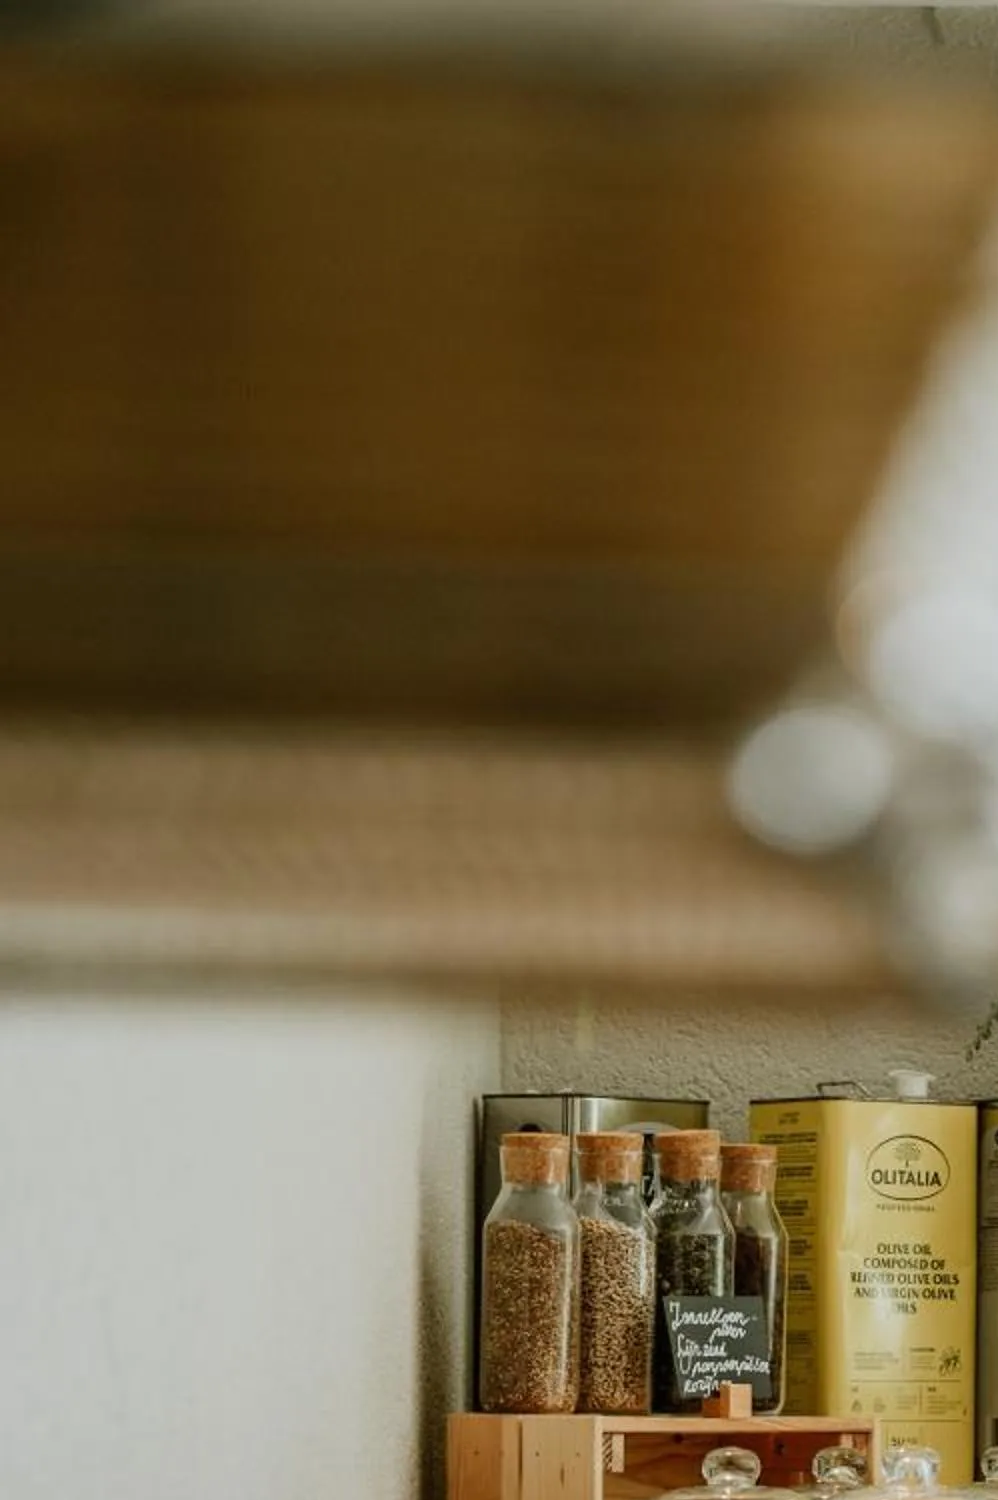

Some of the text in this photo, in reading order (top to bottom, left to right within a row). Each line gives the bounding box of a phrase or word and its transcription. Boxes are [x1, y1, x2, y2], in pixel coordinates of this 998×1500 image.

[871, 1169, 942, 1187] OLITALIA
[877, 1243, 932, 1255] OLIVE OIL
[863, 1257, 945, 1271] COMPOSED OF
[897, 1273, 931, 1285] OLIVE
[932, 1274, 960, 1286] OILS
[854, 1287, 880, 1299] AND
[921, 1288, 957, 1301] OLIVE
